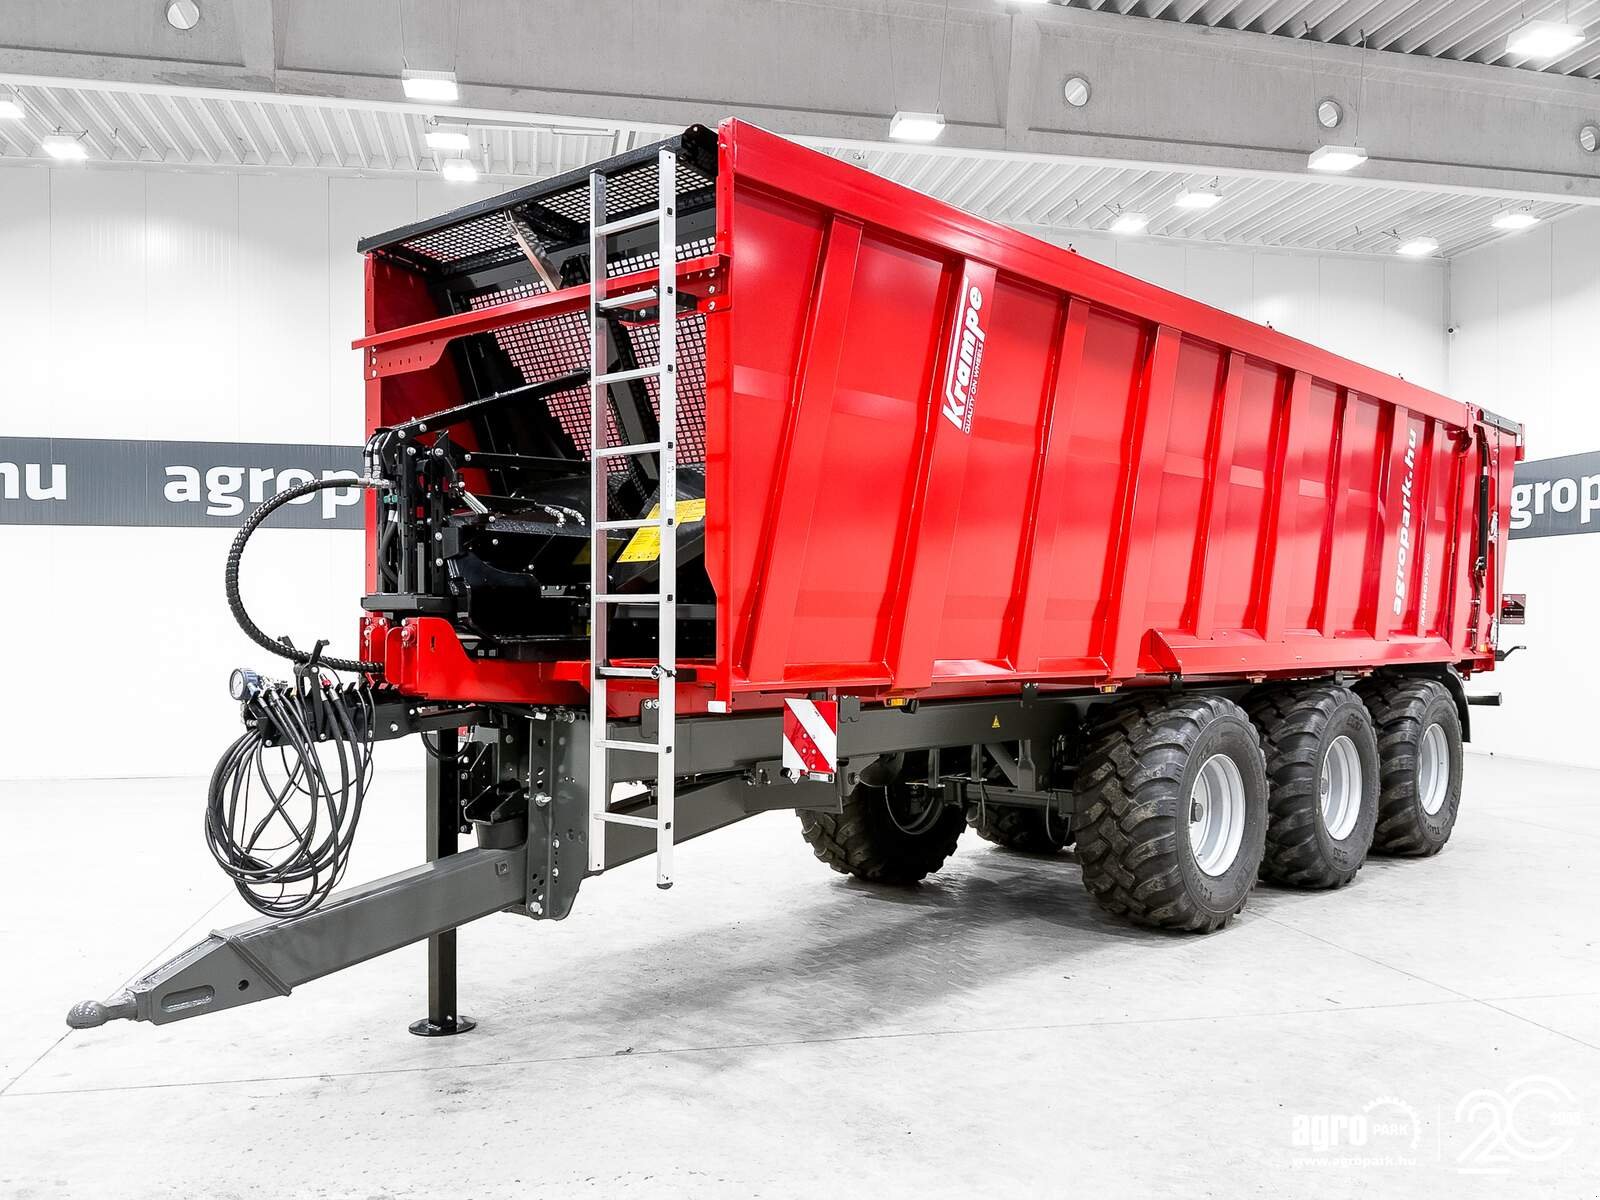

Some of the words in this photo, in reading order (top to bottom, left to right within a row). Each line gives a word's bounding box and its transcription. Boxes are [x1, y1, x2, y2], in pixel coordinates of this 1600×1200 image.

[943, 275, 986, 430] Krampe
[973, 342, 984, 378] WHEELS
[970, 380, 979, 395] ON
[965, 398, 976, 434] QUALITY
[1393, 429, 1417, 615] agropark.hu
